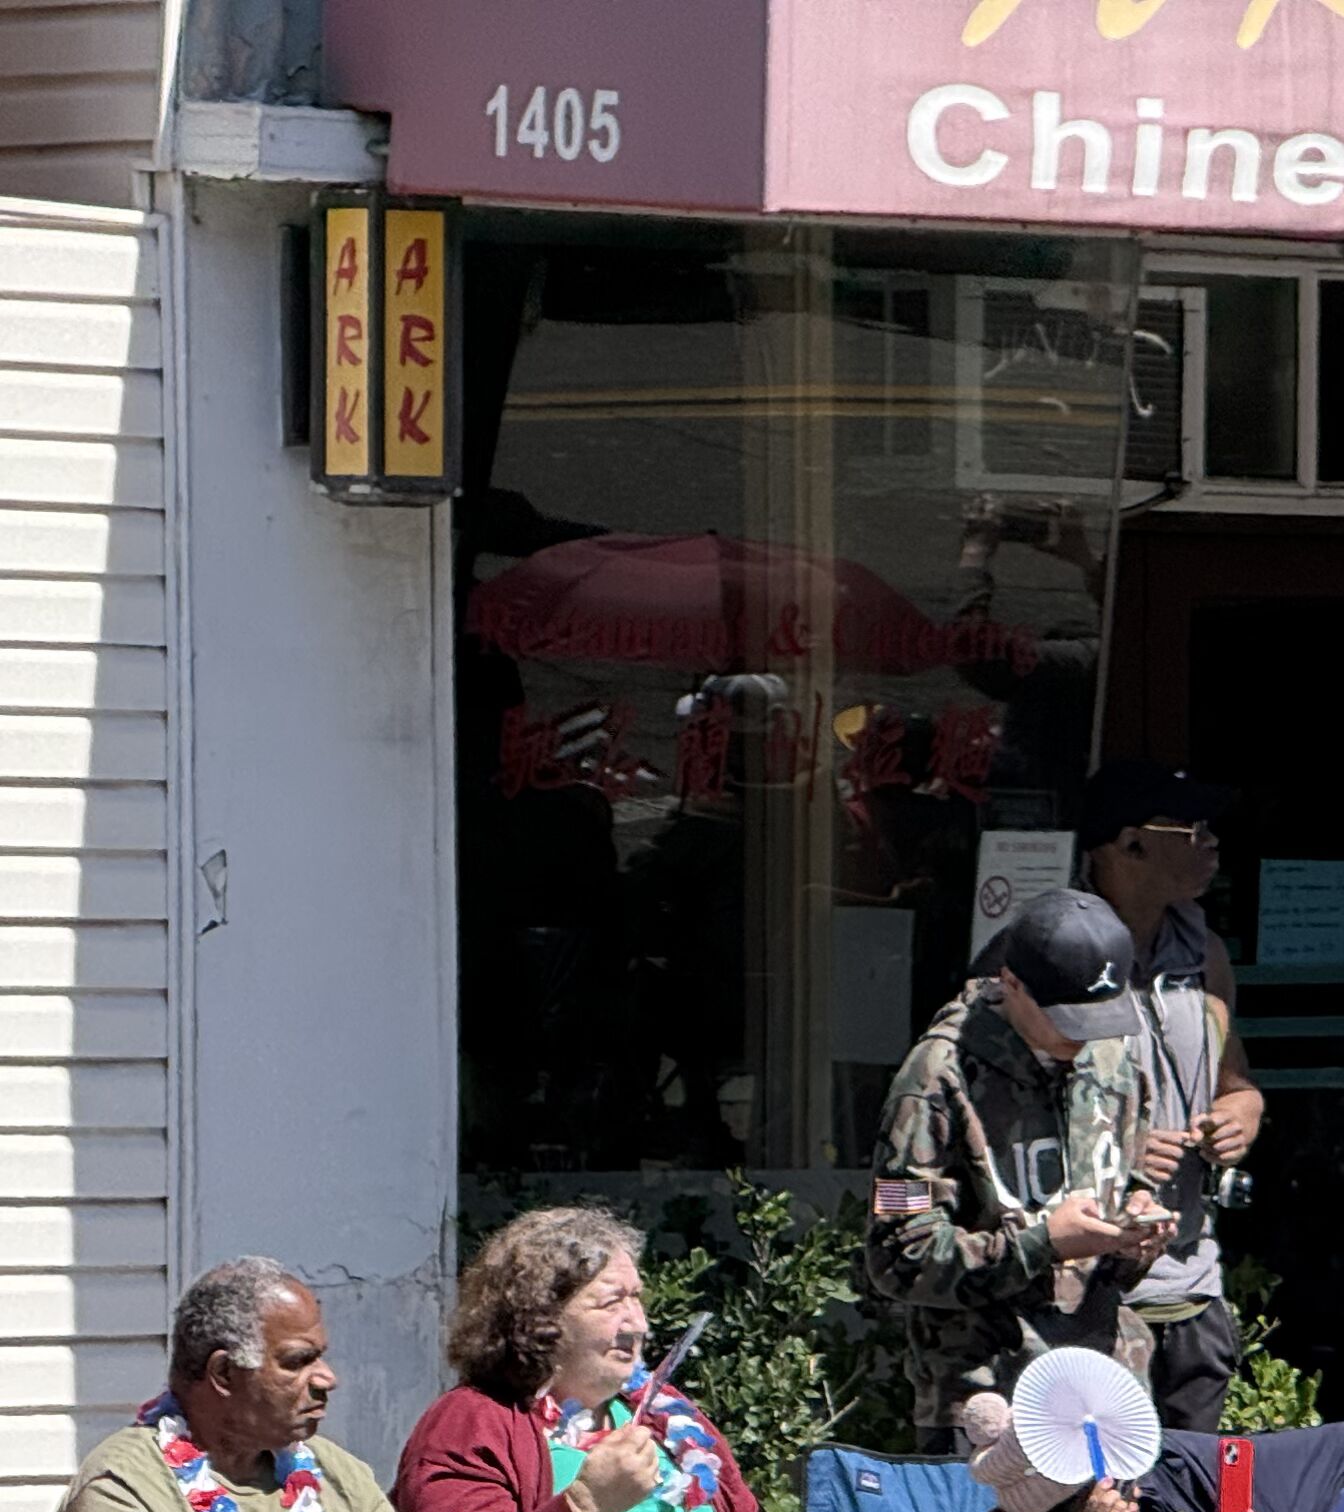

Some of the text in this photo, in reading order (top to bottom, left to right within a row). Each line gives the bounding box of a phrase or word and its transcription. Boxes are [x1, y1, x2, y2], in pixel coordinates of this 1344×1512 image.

[486, 85, 620, 162] 1405
[333, 237, 365, 444] ARK
[395, 238, 432, 446] ARK
